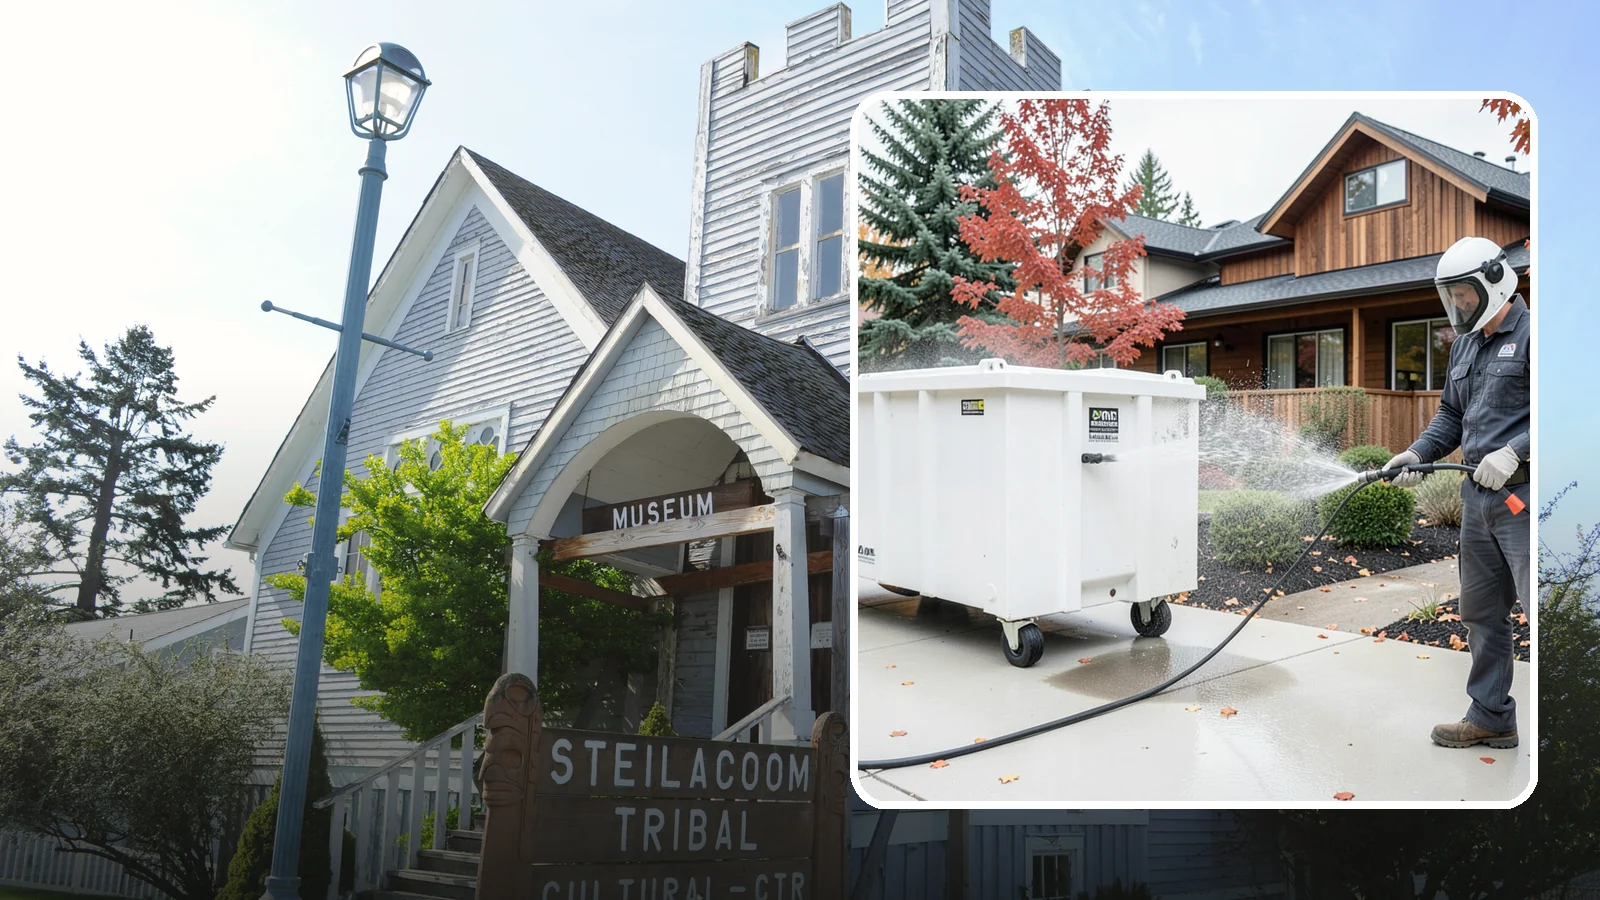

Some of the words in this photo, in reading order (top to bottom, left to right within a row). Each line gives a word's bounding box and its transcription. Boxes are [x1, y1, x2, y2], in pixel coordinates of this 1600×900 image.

[613, 492, 714, 531] MUSEUM
[551, 738, 809, 792] STEILACOOM
[615, 807, 757, 851] TRIBAL
